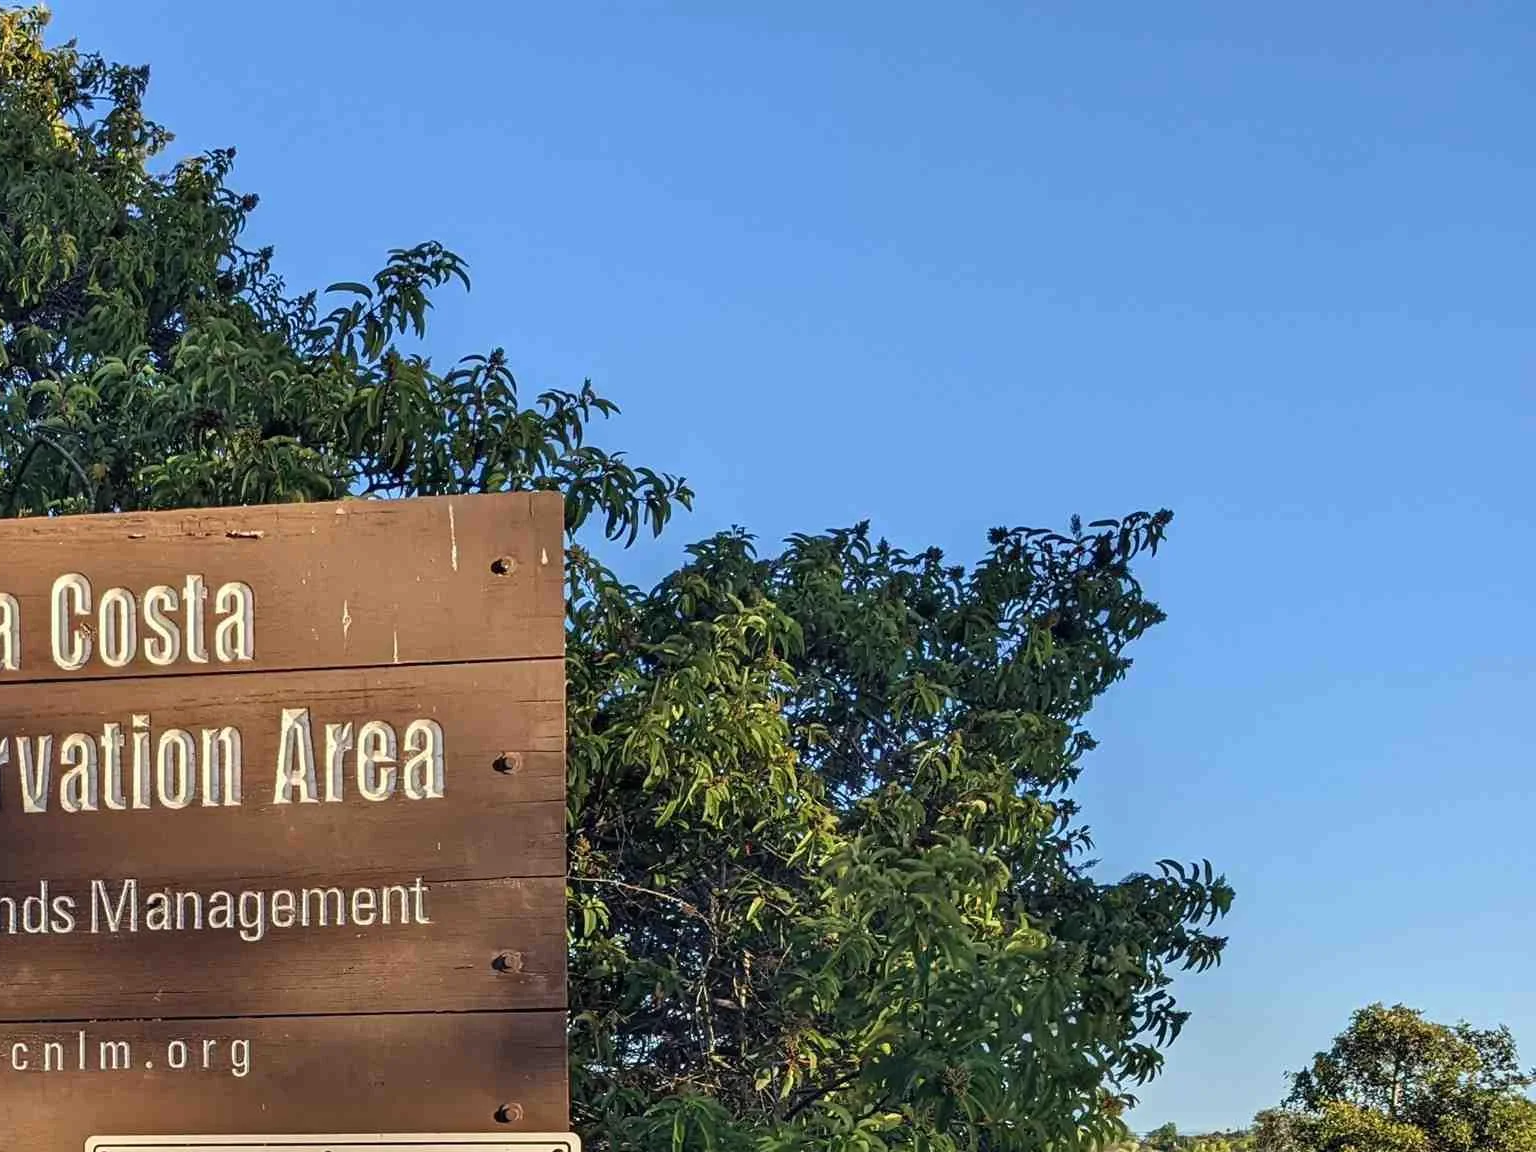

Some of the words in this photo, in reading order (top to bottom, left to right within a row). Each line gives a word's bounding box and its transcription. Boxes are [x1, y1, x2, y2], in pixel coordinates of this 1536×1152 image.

[51, 572, 256, 671] Costa
[274, 708, 445, 805] Area
[91, 877, 430, 941] Management
